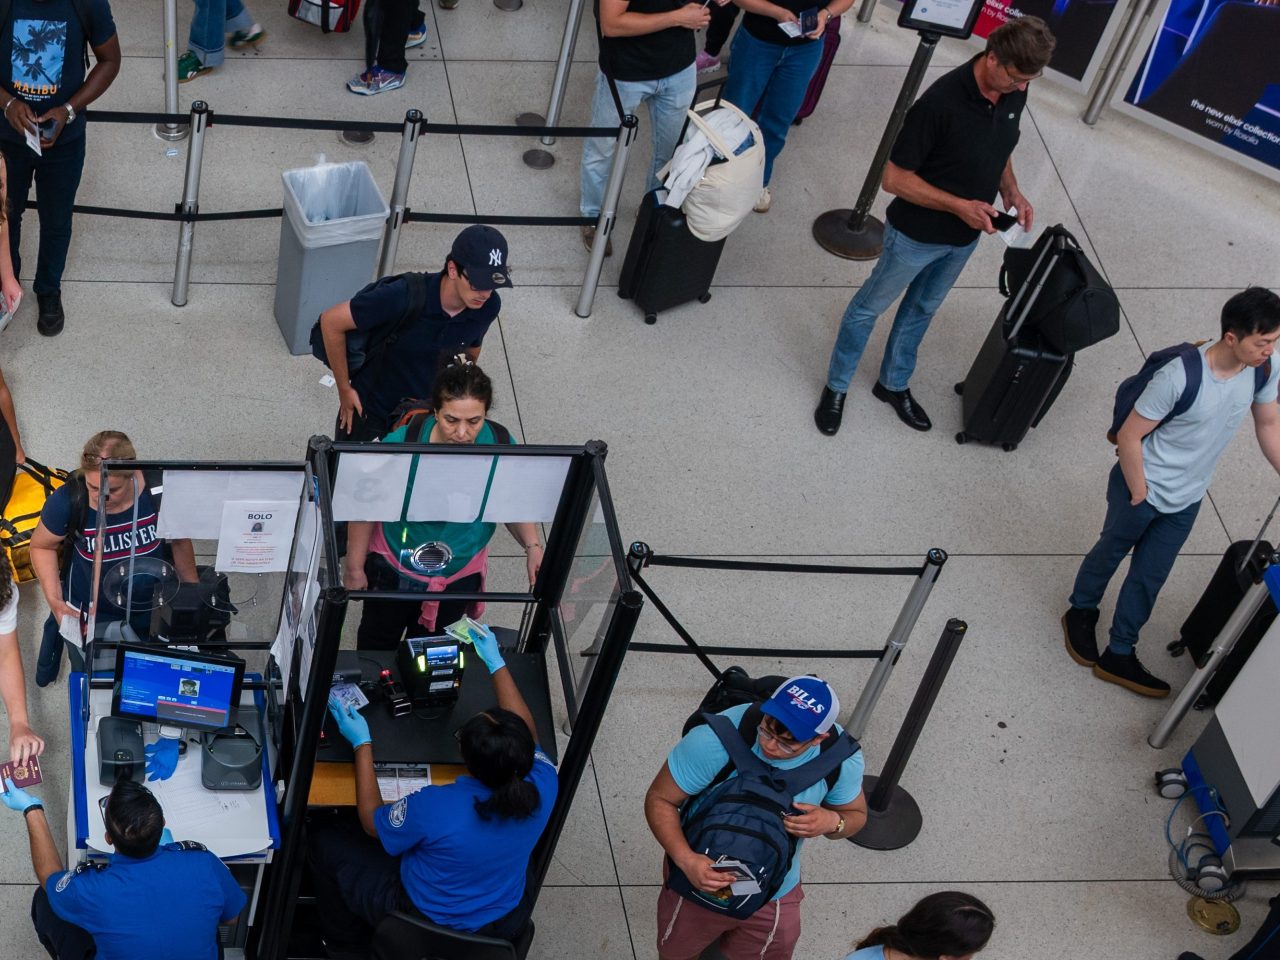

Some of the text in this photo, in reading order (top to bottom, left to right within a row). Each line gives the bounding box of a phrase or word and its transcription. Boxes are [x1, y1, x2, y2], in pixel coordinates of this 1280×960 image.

[14, 81, 57, 94] MALIBU
[1190, 98, 1205, 111] the
[1205, 106, 1224, 119] new
[1223, 125, 1234, 136] by
[786, 685, 825, 713] BILLS
